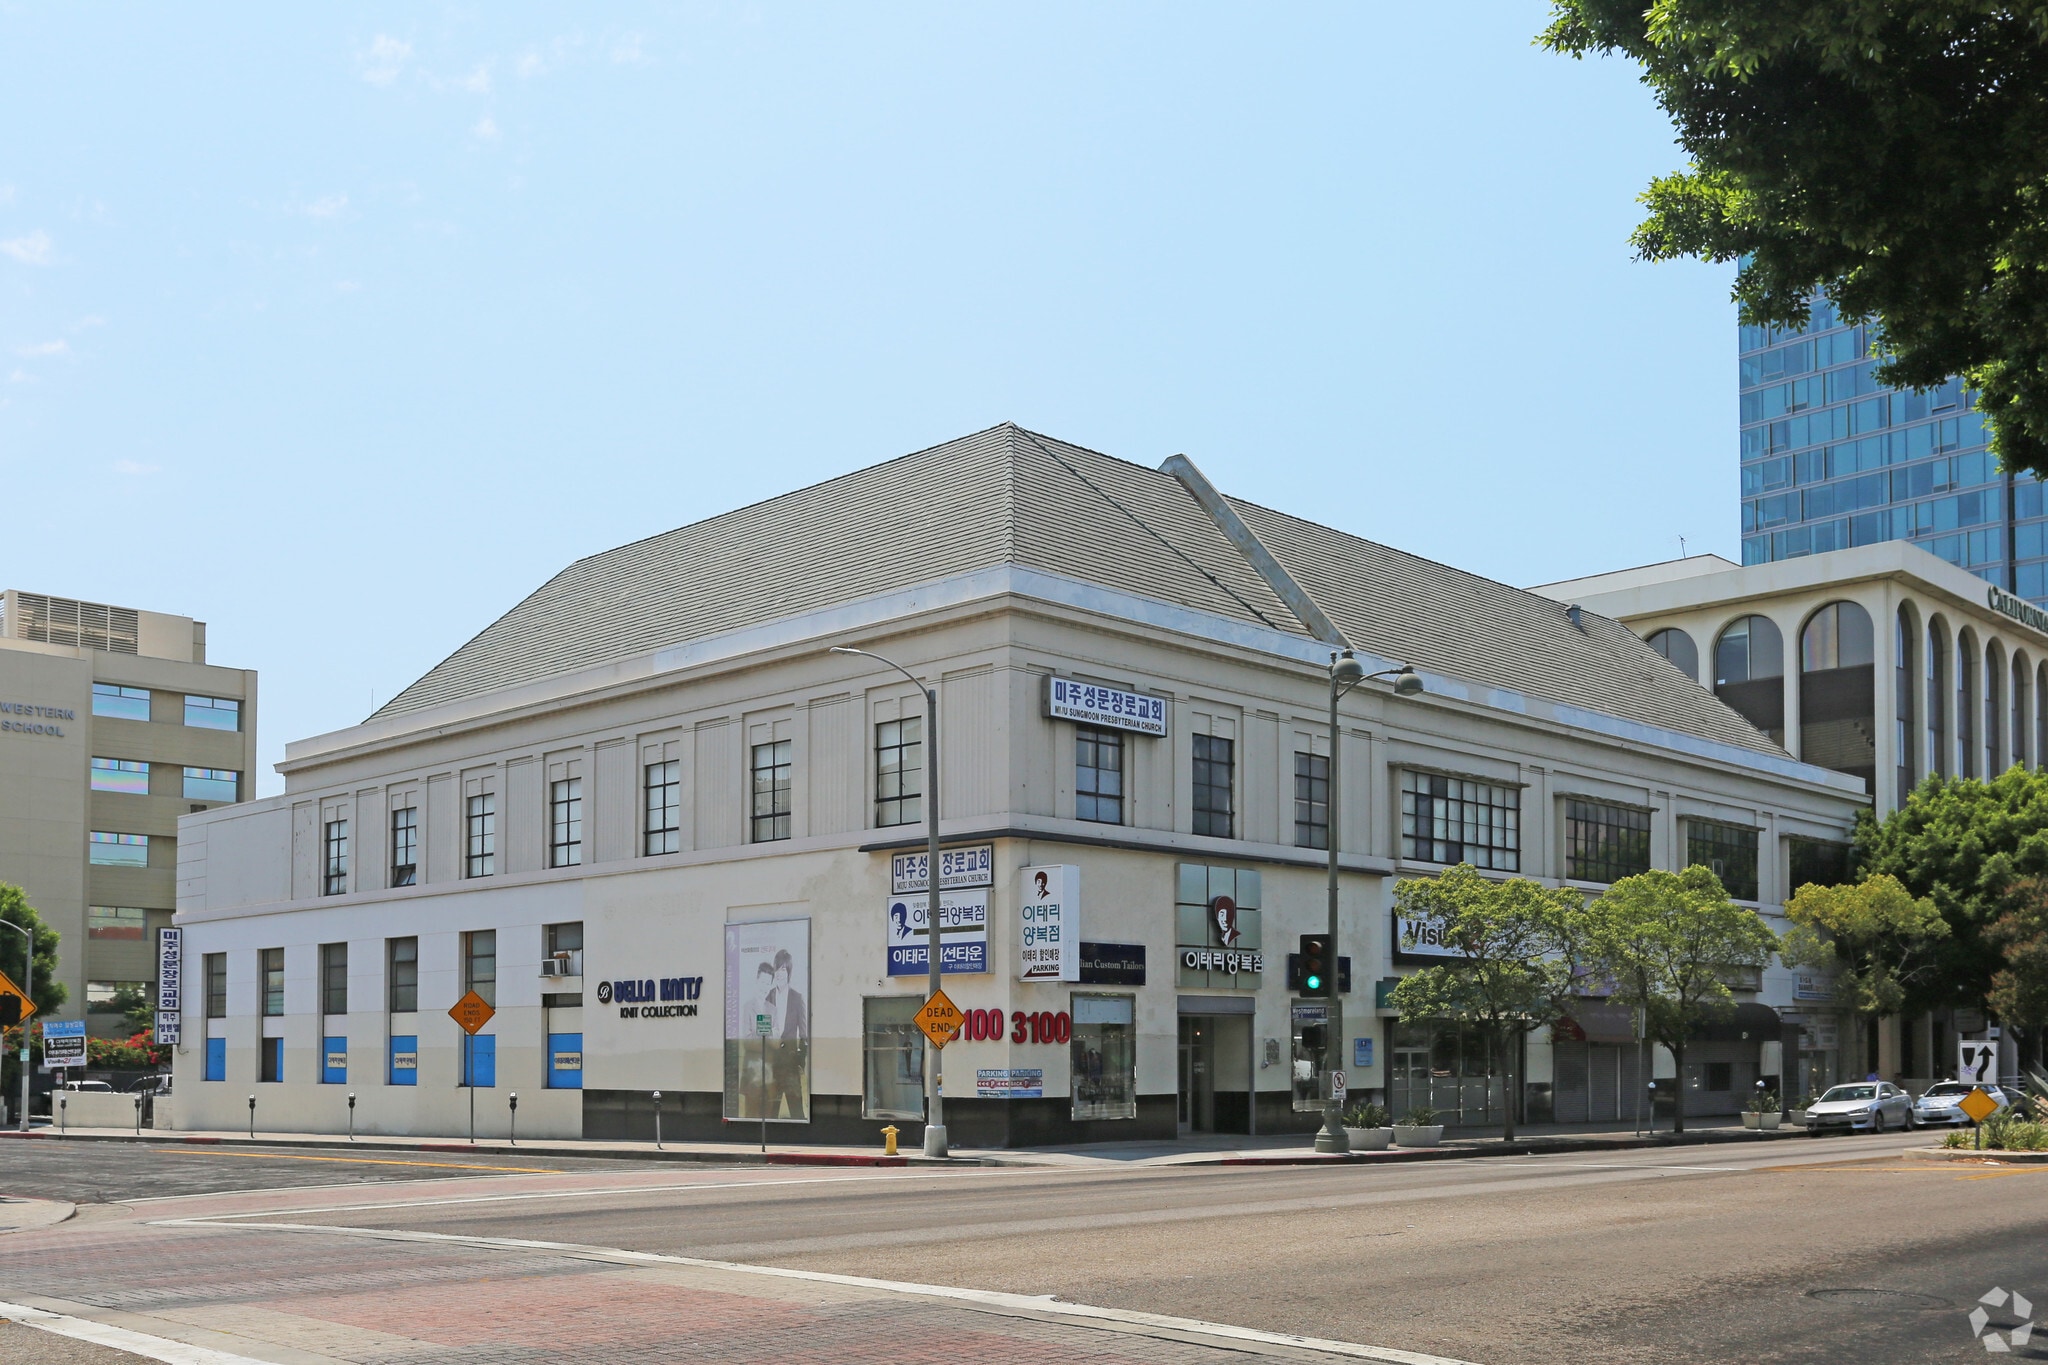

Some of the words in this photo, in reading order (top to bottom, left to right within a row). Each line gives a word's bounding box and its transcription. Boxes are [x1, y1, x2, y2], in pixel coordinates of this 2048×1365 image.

[1055, 681, 1162, 722] 미주성문장로교회
[2, 719, 65, 738] SCHOOL
[1069, 708, 1100, 721] SUNGMOON
[1100, 713, 1141, 729] PRESBYTERIAN
[1141, 721, 1163, 733] CHURCH
[895, 848, 990, 880] 미주성장로교회
[967, 873, 989, 883] CHURCH
[1022, 904, 1060, 922] 이태리
[1023, 925, 1060, 946] 양복점
[893, 945, 983, 965] 이태리션타운
[1022, 949, 1037, 961] 이태리
[1094, 958, 1121, 969] Custom
[1121, 960, 1145, 970] Tailors
[1186, 951, 1264, 975] 이태리양복점
[162, 931, 178, 1008] 미주성문장로교회
[1032, 964, 1060, 972] PARKING
[613, 980, 655, 1003] BELLA
[660, 976, 703, 1001] KNITS
[162, 1013, 176, 1021] 미주
[620, 1006, 639, 1018] KNIT
[641, 1004, 697, 1018] COLLECTION
[926, 1007, 953, 1018] DEAD
[930, 1022, 950, 1033] END
[950, 1008, 1004, 1041] 100
[1010, 1011, 1070, 1044] 3100
[163, 1034, 176, 1043] 교회
[1011, 1070, 1042, 1078] PARKING
